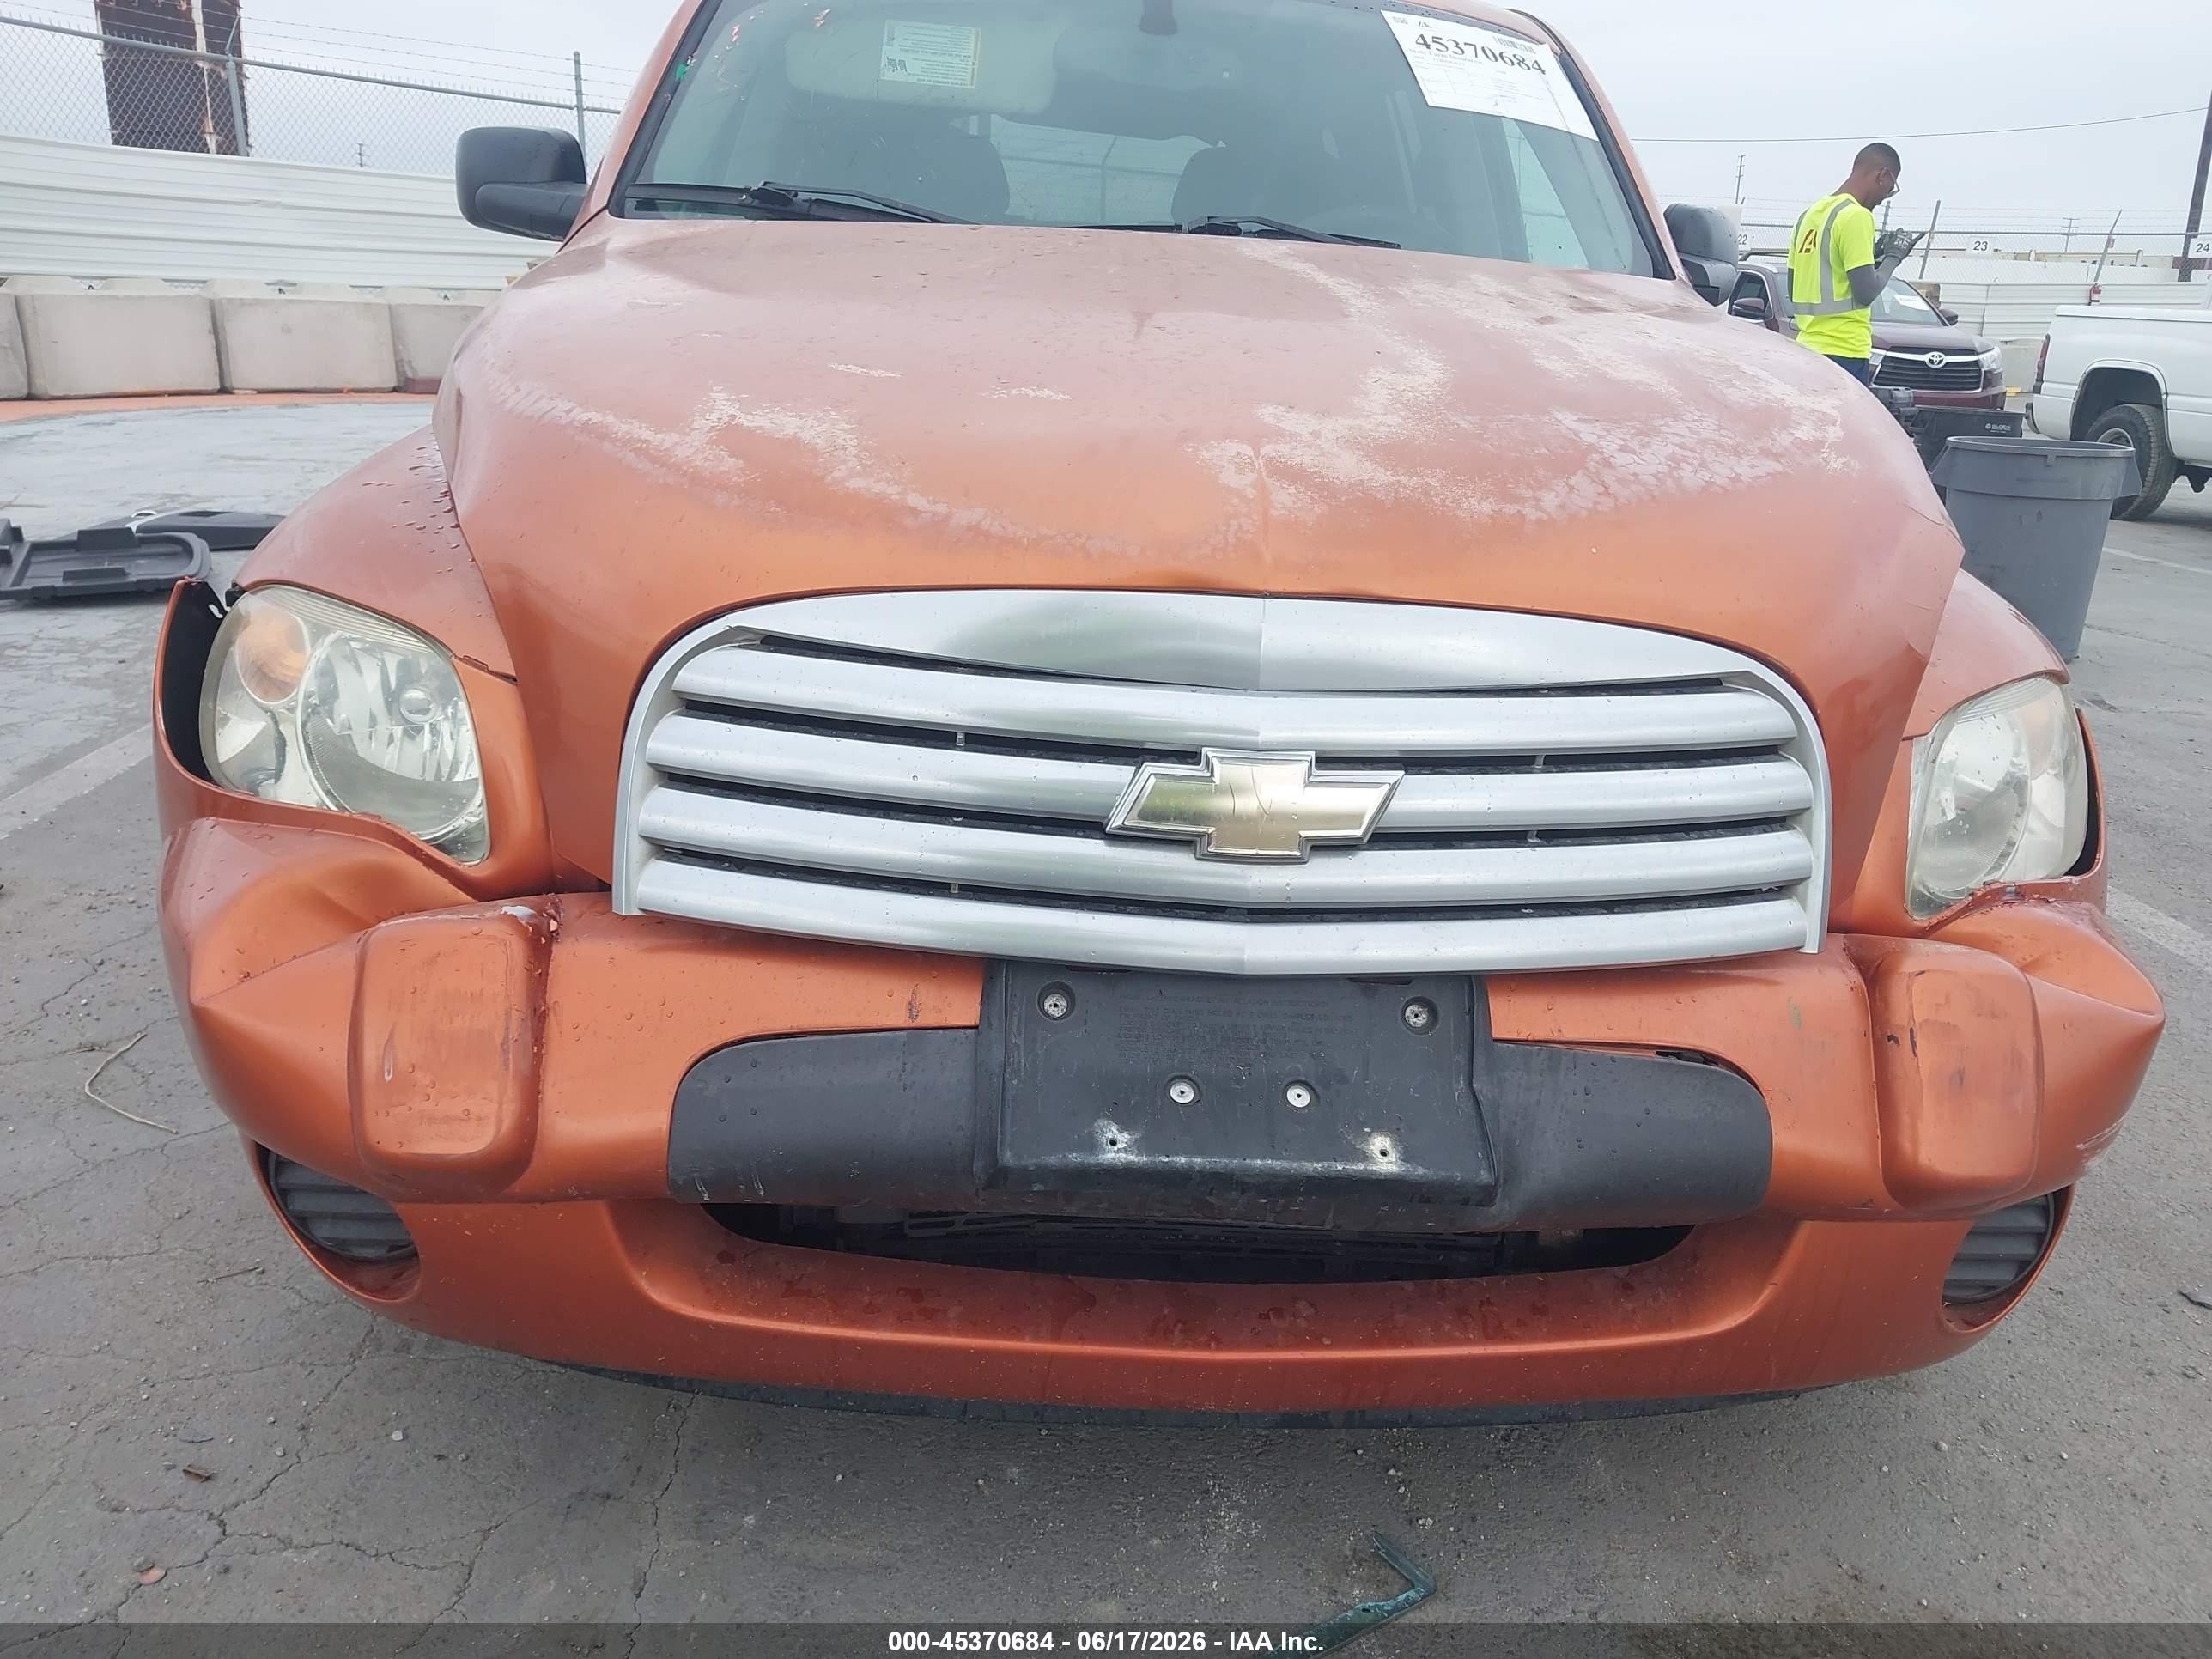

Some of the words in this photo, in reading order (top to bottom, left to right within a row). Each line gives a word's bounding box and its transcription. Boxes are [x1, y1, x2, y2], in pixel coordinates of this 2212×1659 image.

[1415, 33, 1546, 75] 45370684
[1973, 240, 1988, 251] 23
[2195, 242, 2210, 253] 24
